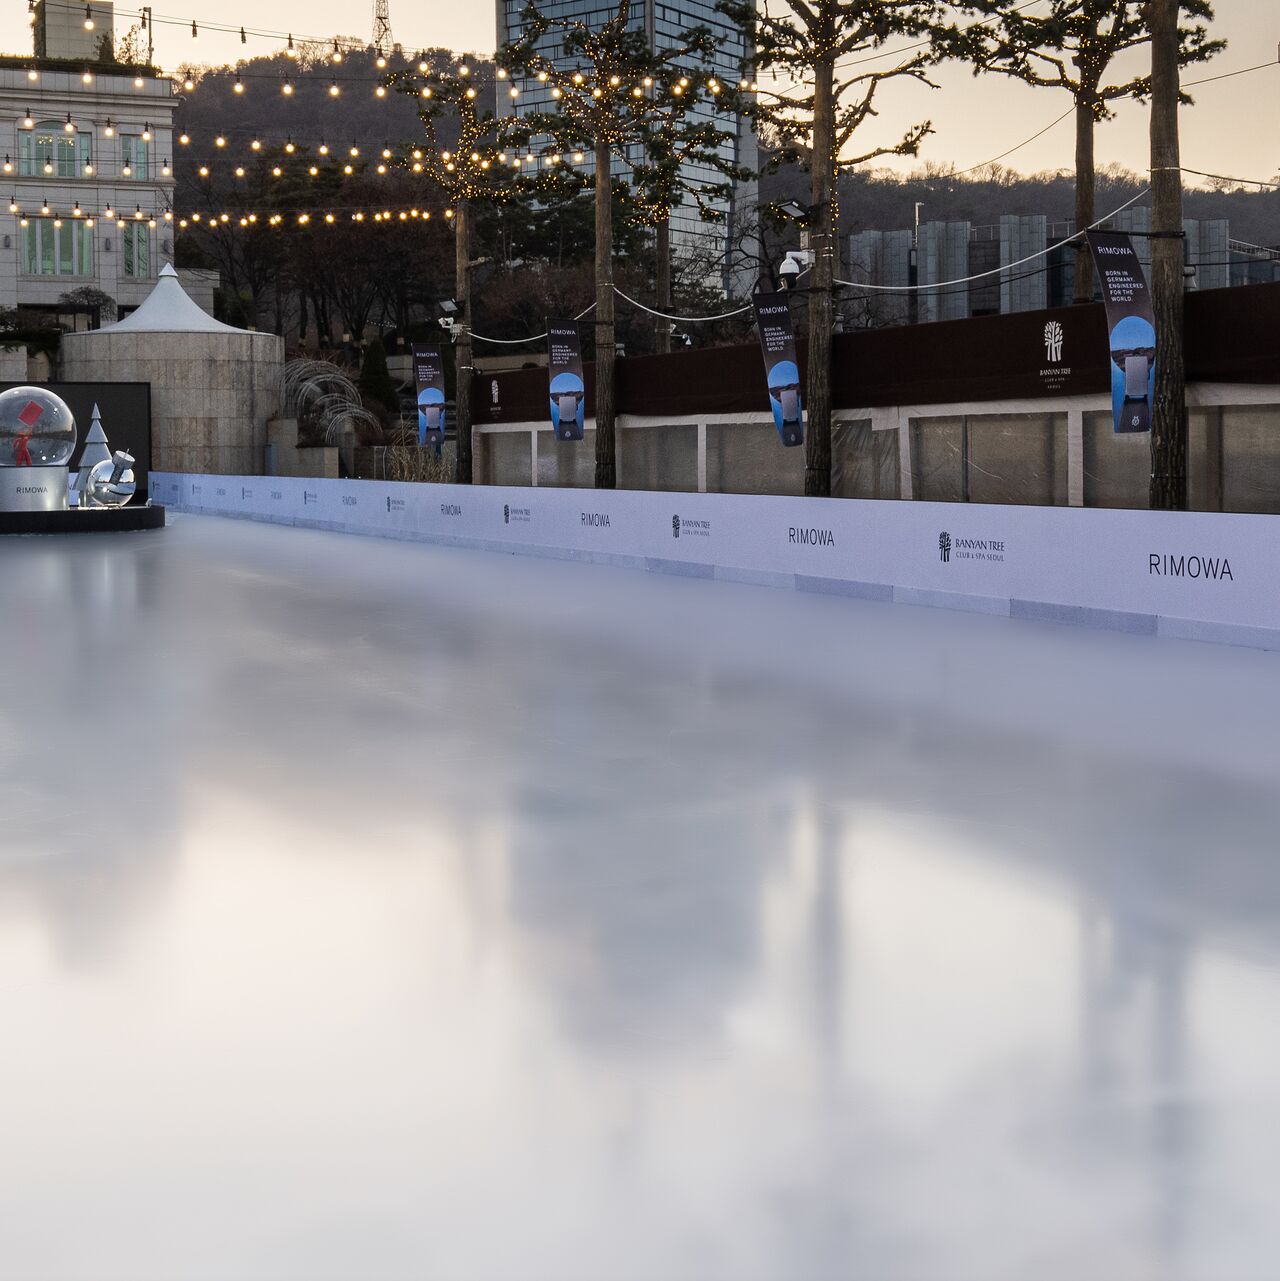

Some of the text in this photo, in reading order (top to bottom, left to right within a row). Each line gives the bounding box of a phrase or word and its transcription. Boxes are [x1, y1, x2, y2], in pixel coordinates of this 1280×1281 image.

[1097, 246, 1133, 255] RIMOWA
[759, 305, 789, 314] RIMOWA
[16, 486, 49, 494] RIMOWA
[581, 512, 611, 527] RIMOWA
[788, 527, 835, 546] RIMOWA
[955, 538, 1005, 551] BANYAN TREE
[1149, 553, 1234, 581] RIMOWA
